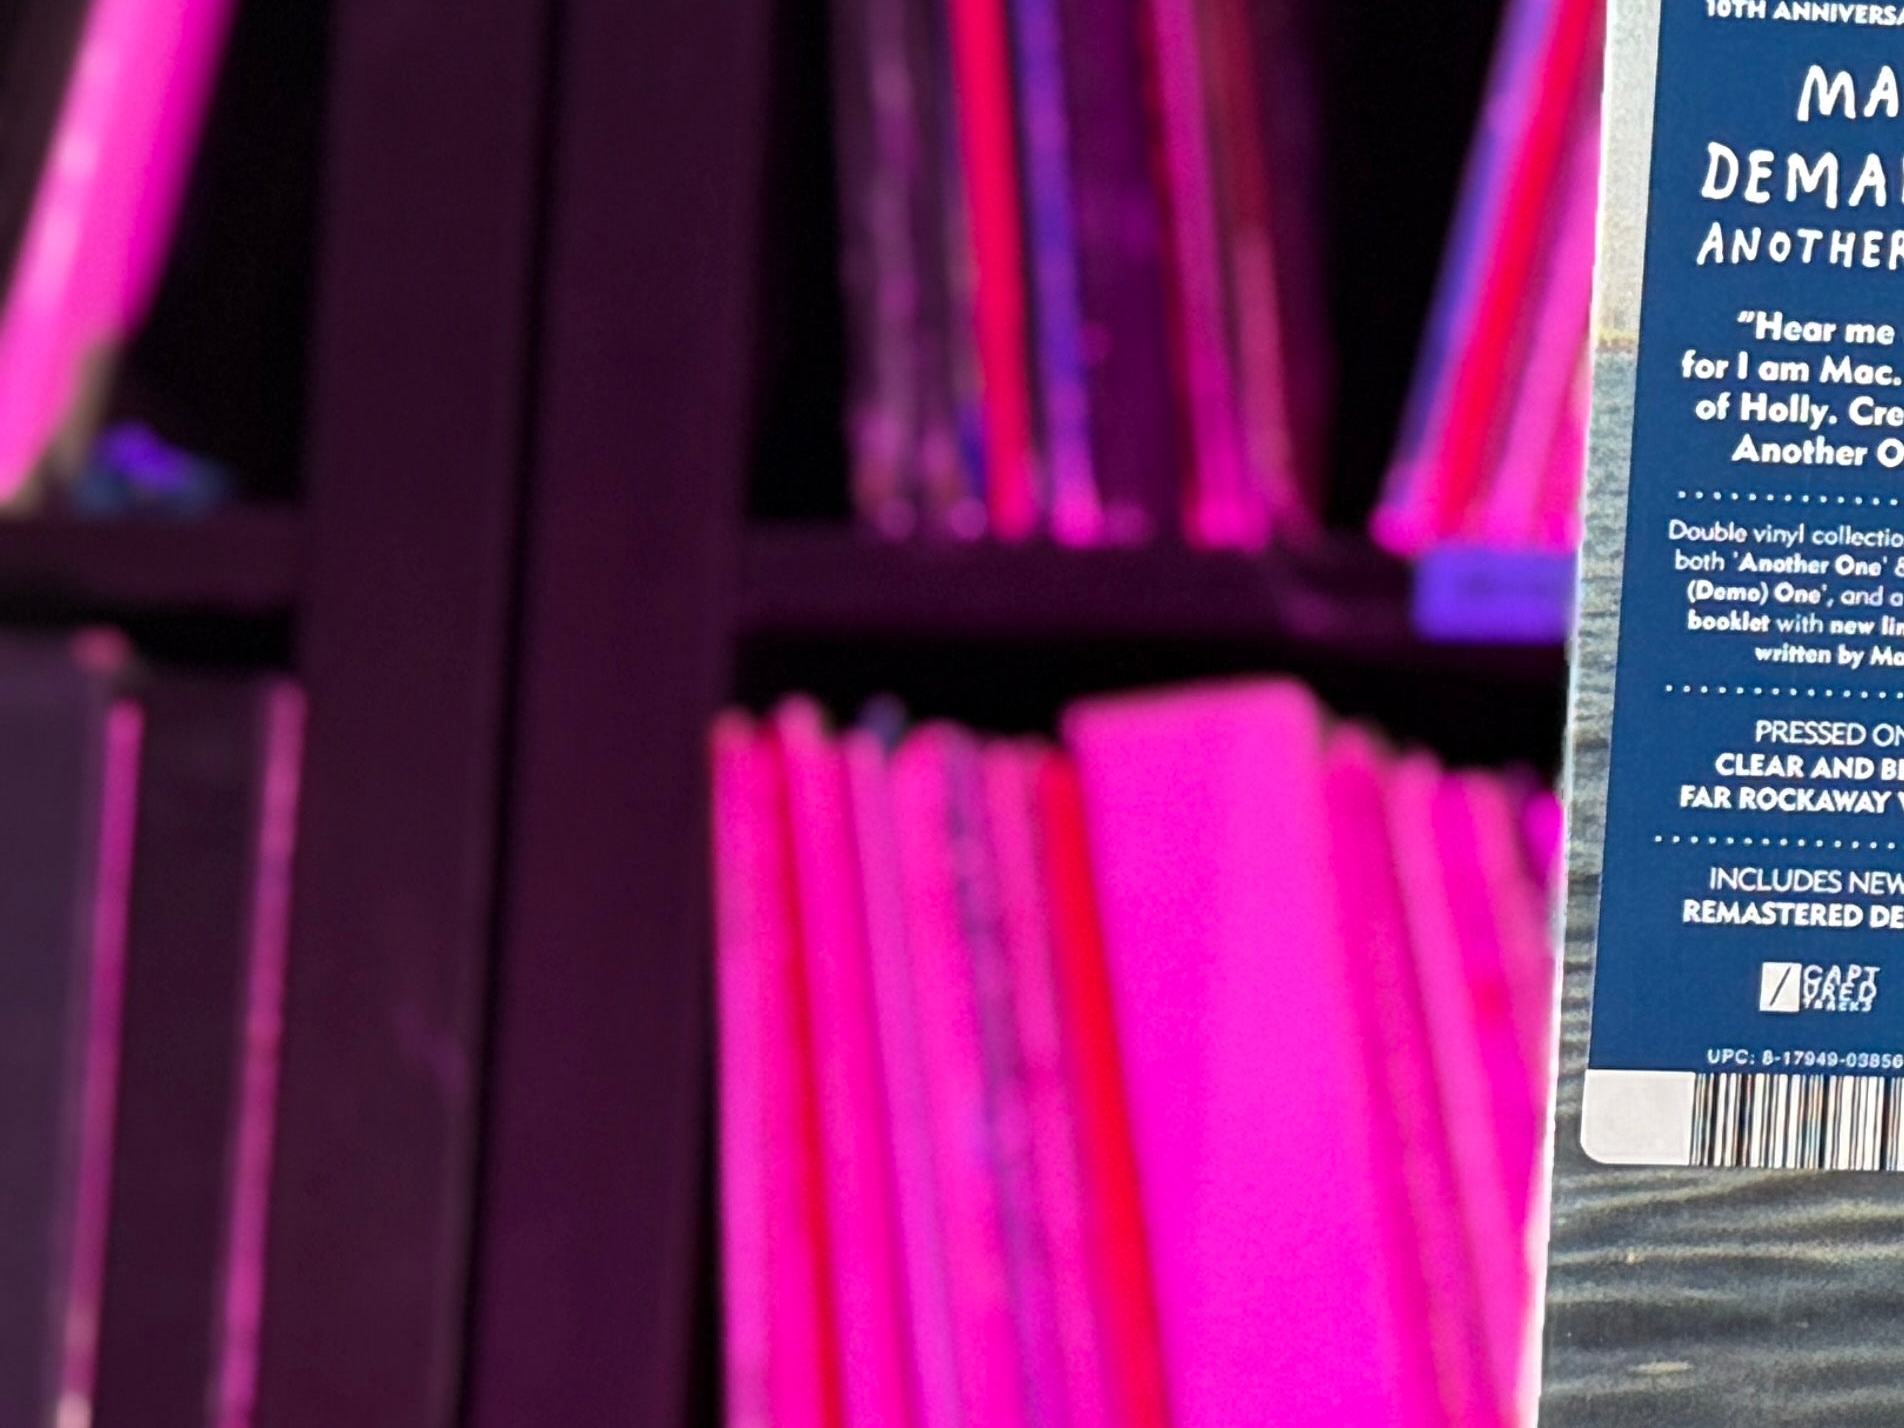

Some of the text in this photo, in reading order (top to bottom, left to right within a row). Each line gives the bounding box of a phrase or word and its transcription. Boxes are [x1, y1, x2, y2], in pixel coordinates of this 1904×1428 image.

[1845, 324, 1895, 345] me
[1682, 349, 1729, 379] for
[1737, 351, 1748, 379] I
[1758, 361, 1809, 382] am
[1819, 355, 1902, 386] Mac.
[1695, 392, 1731, 420] of
[1740, 392, 1837, 430] Holly.
[1731, 433, 1868, 466] Another
[1669, 519, 1747, 543] Double
[1753, 523, 1804, 547] vinyl
[1675, 549, 1725, 571] both
[1687, 579, 1769, 605] (Demo)
[1840, 586, 1883, 606] and
[1889, 592, 1903, 606] a
[1688, 609, 1771, 632] booklet
[1776, 613, 1823, 633] with
[1829, 620, 1875, 635] new
[1755, 643, 1831, 663] written
[1837, 644, 1864, 669] by
[1756, 720, 1866, 745] PRESSED
[1715, 753, 1804, 778] CLEAR
[1810, 757, 1874, 780] AND
[1680, 785, 1732, 808] FAR
[1739, 786, 1892, 813] ROCKAWAY
[1710, 867, 1842, 893] INCLUDES
[1683, 899, 1863, 927] REMASTERED
[1708, 1049, 1754, 1065] UPC:
